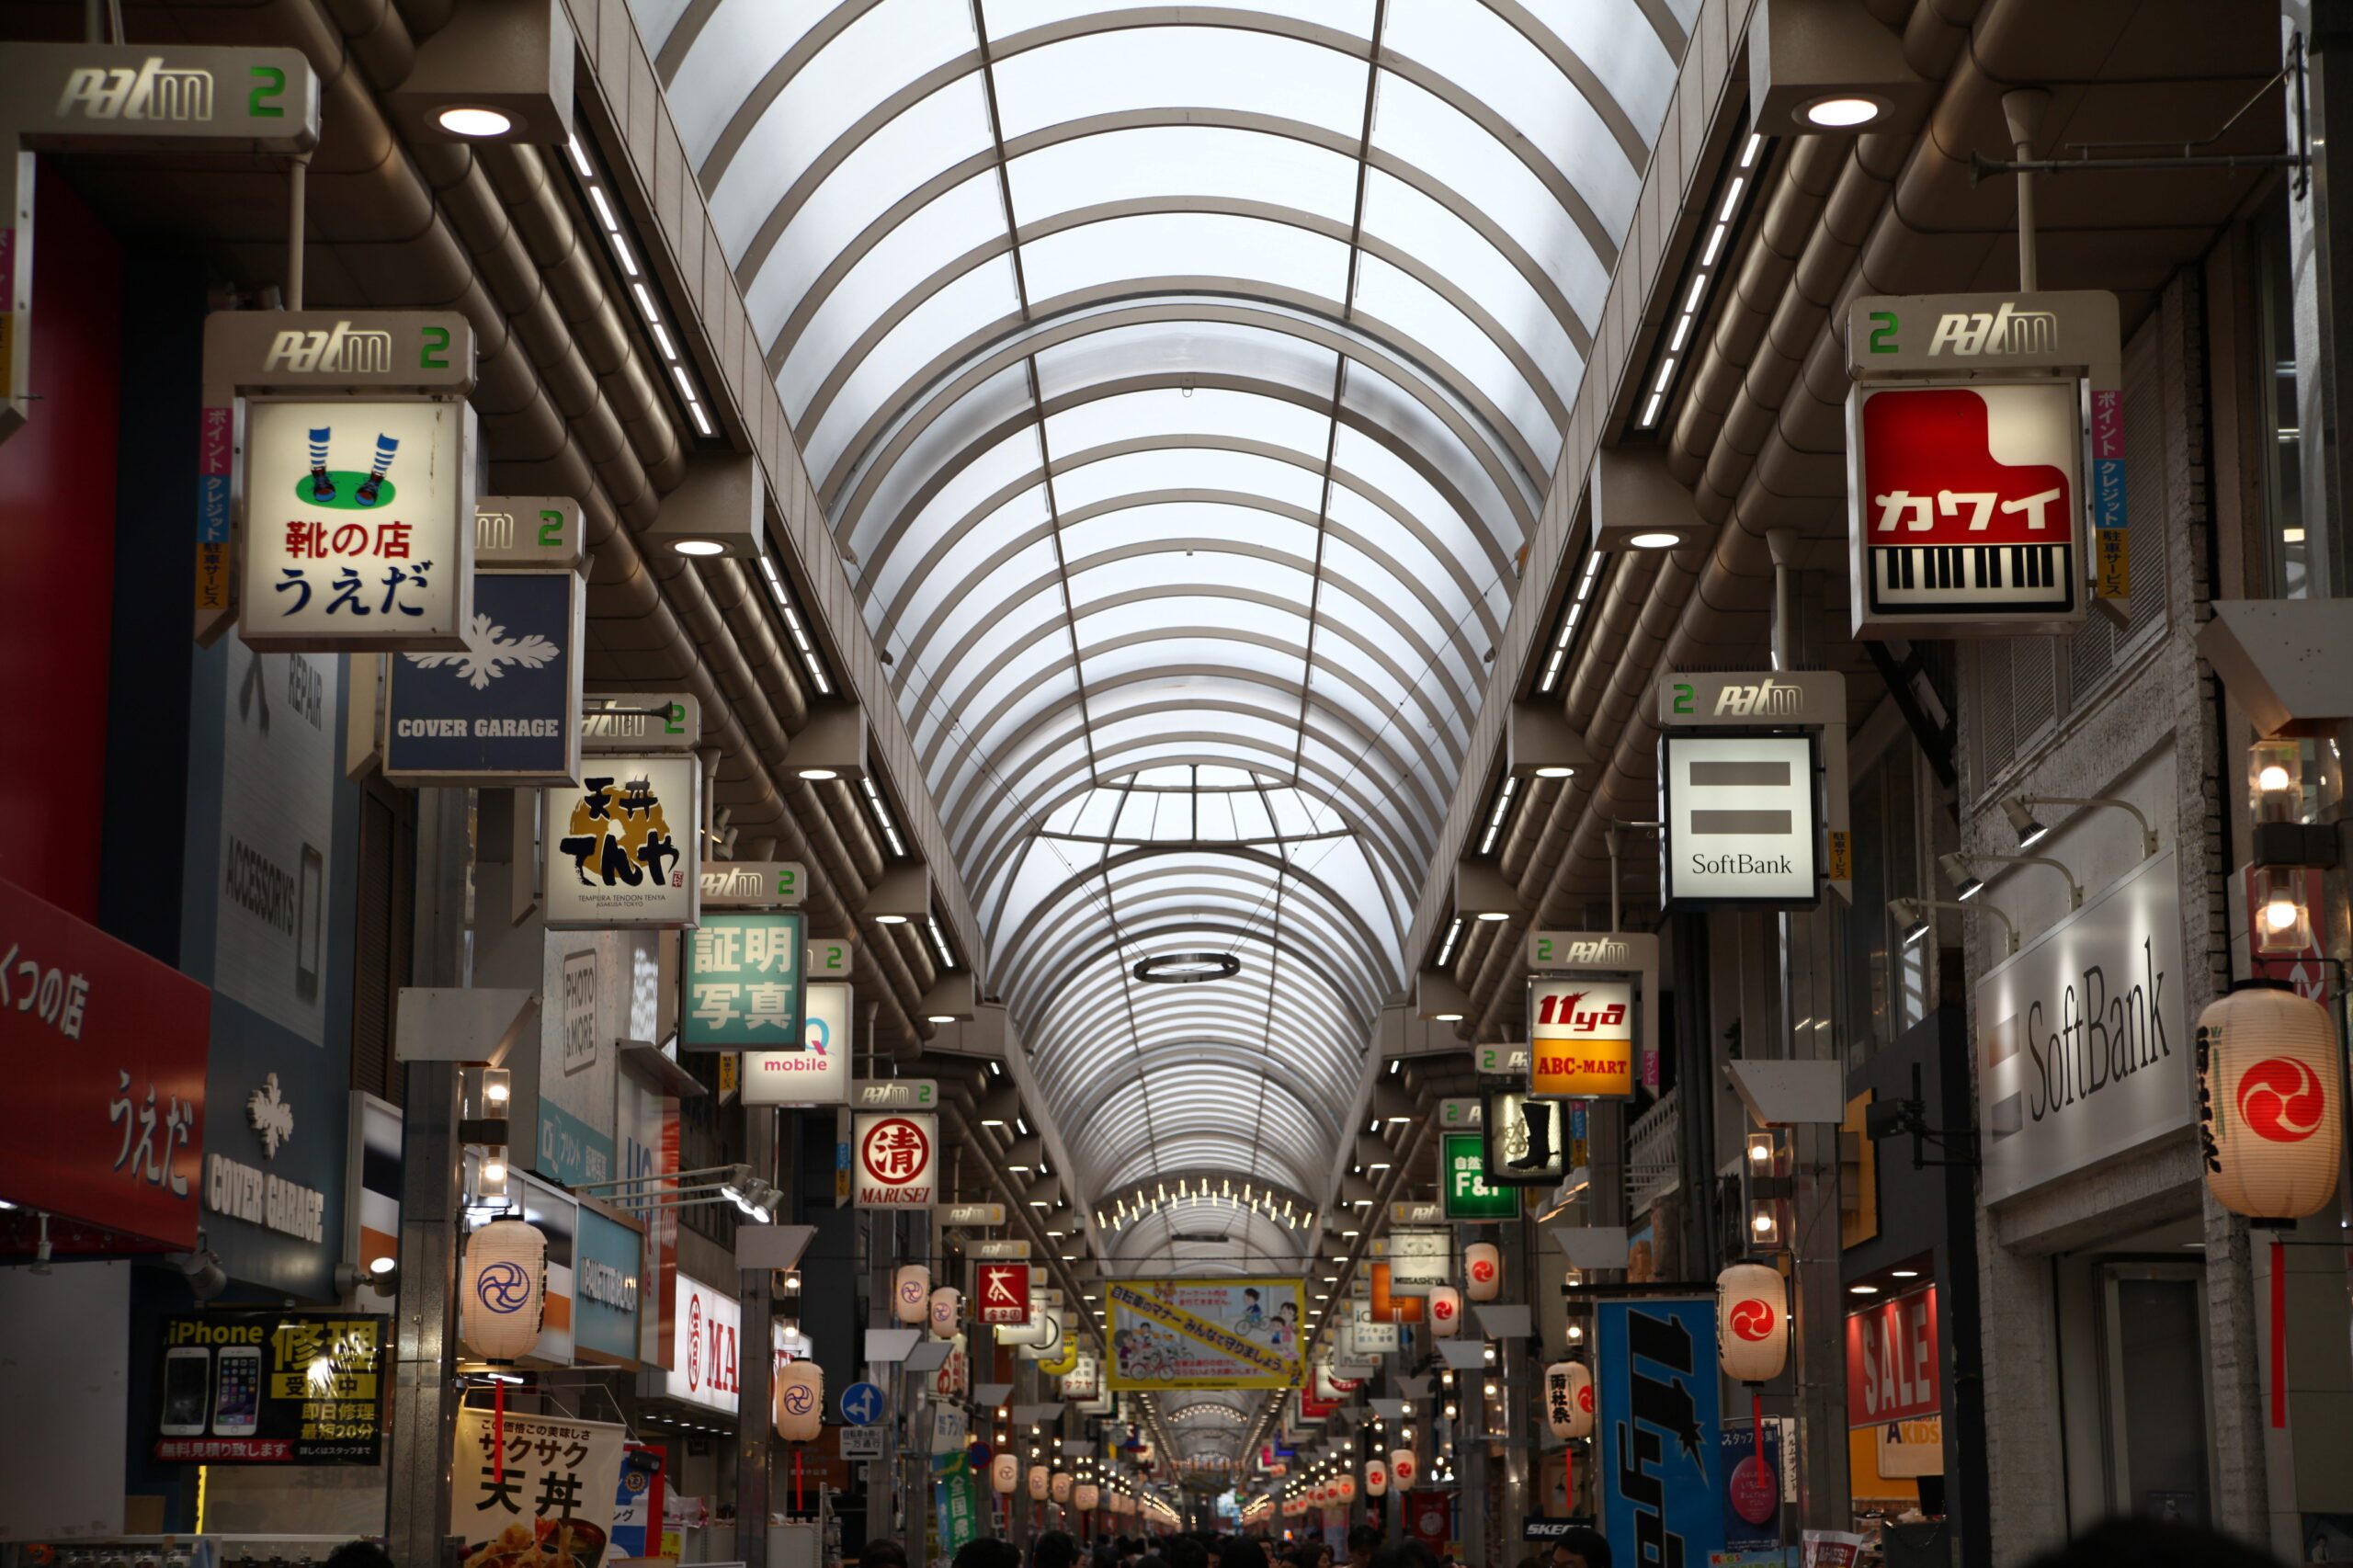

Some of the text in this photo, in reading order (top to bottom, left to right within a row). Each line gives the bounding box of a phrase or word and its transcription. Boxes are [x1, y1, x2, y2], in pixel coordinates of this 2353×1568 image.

[249, 66, 286, 118] 2
[420, 326, 450, 369] 2
[1870, 312, 1899, 354] 2
[208, 409, 227, 472] ポイント
[2097, 391, 2117, 457] ポイント
[205, 476, 223, 540] クレジット
[1875, 487, 2061, 531] カワイ
[2099, 460, 2120, 526] クレジット
[285, 521, 413, 559] 靴の店
[539, 509, 564, 547] 2
[200, 542, 222, 607] 駐車サービス
[2103, 529, 2122, 595] 駐車サービス
[275, 559, 434, 617] うえだ
[1673, 683, 1695, 714] 2
[397, 718, 559, 738] COVER GARAGE
[559, 827, 681, 888] てんや
[1691, 853, 1793, 875] SoftBank
[225, 835, 296, 937] ACCESSORYS
[578, 892, 666, 903] TEMPURA TENDON TENYA
[778, 870, 795, 895] 2
[692, 926, 793, 974] 証明
[826, 947, 843, 970] 2
[1538, 938, 1553, 961] 2
[565, 966, 596, 1012] PHOTO
[691, 982, 793, 1030] 写真
[2028, 934, 2171, 1123] SoftBank
[764, 1057, 828, 1072] mobile
[1483, 1050, 1496, 1069] 2
[1537, 1057, 1628, 1075] ABC-MART
[919, 1085, 931, 1103] 2
[1446, 1104, 1460, 1122] 2
[110, 1069, 193, 1195] うえだ
[874, 1126, 922, 1176] 清
[205, 1153, 324, 1244] COVER GARAGE
[858, 1187, 932, 1204] MARUSEI
[1394, 1277, 1447, 1286] MUSASHIYA
[168, 1320, 264, 1345] iPhone
[270, 1318, 379, 1371] 修理
[1862, 1301, 1931, 1415] SALE
[284, 1377, 359, 1398] 受中
[301, 1402, 376, 1422] 即日修理
[301, 1422, 374, 1441] 最短20分
[160, 1442, 287, 1458] 無料見積り致します
[299, 1446, 371, 1456] 詳しくはスタッフまで
[478, 1432, 589, 1470] サクサク
[476, 1466, 583, 1521] 天丼
